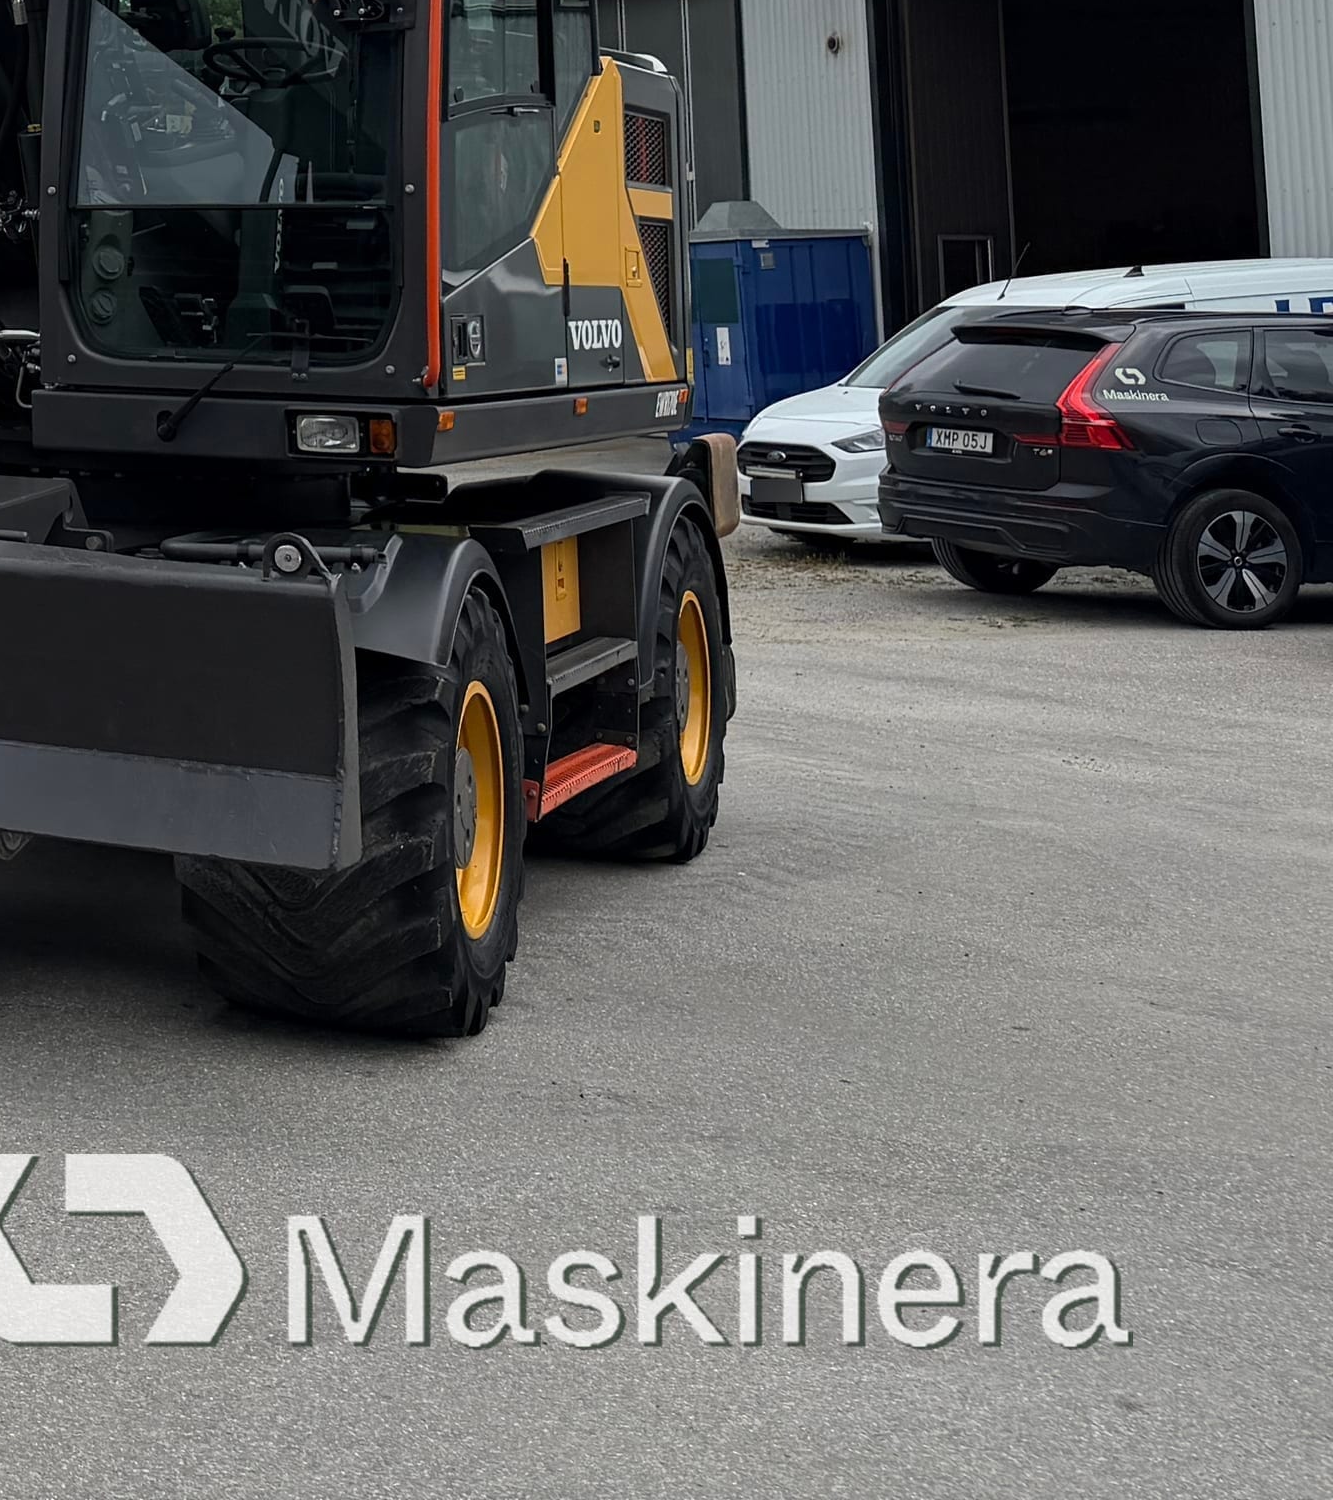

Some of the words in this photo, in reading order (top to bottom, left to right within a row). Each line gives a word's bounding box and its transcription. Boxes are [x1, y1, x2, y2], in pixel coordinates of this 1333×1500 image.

[567, 319, 623, 350] VOLVO
[1102, 389, 1170, 401] Maskinera
[914, 403, 988, 417] VOLVO
[962, 432, 987, 450] 05J
